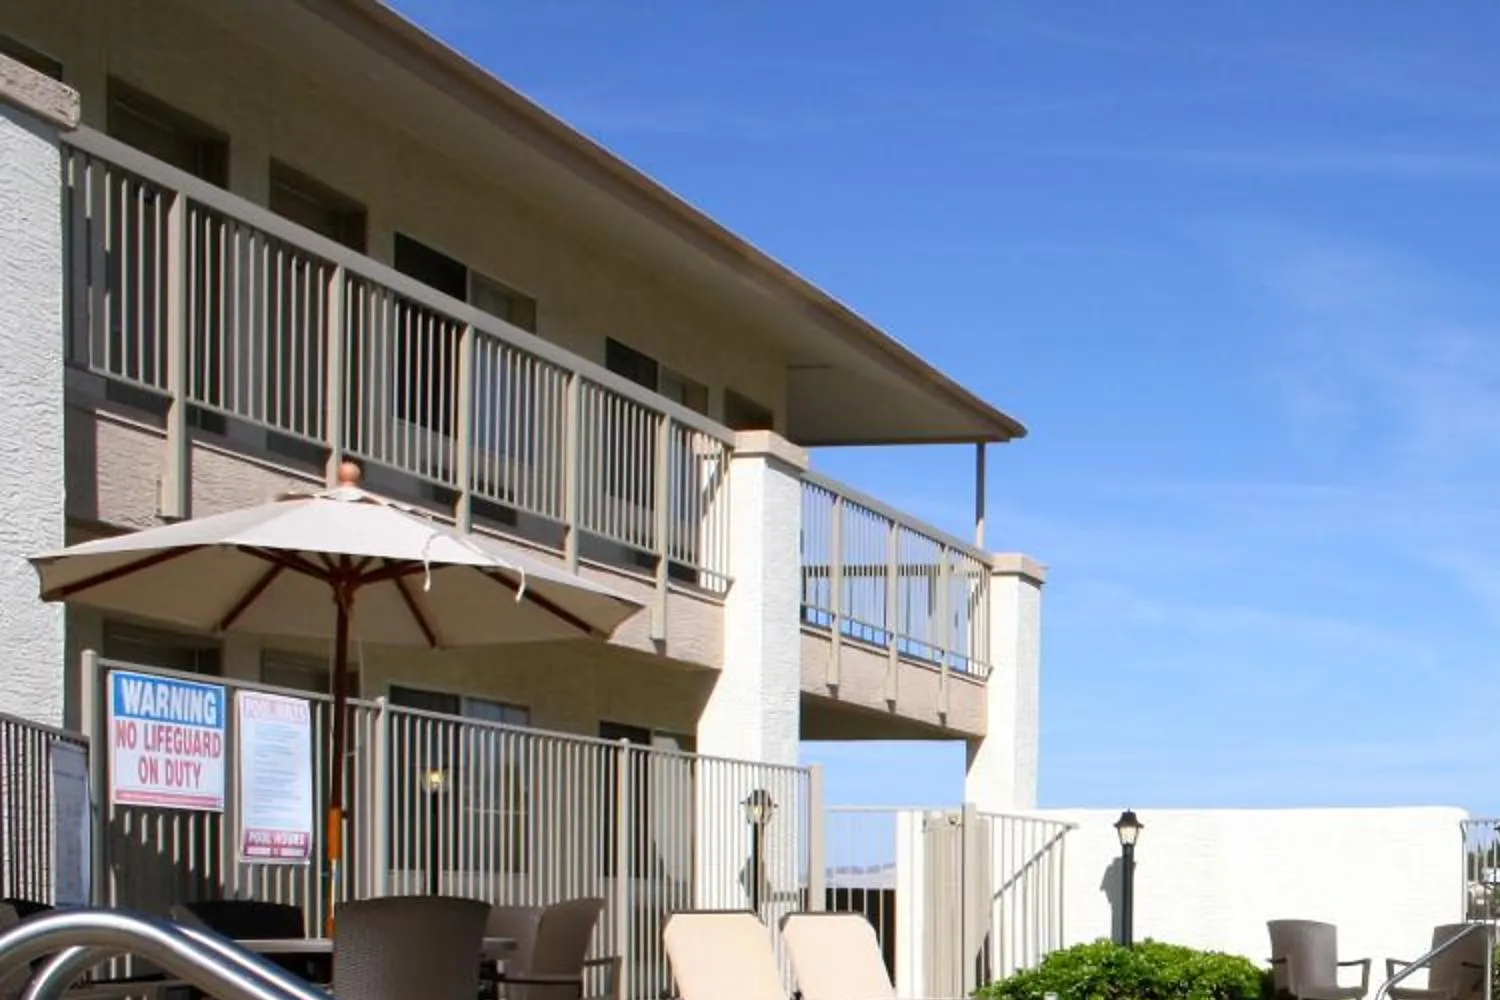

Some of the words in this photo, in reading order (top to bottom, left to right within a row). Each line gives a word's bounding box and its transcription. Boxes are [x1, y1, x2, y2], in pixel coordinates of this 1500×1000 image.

[122, 679, 216, 725] WARNING
[115, 719, 137, 750] NO
[143, 724, 222, 759] LIFEGUARD
[137, 756, 159, 785] ON
[165, 757, 202, 789] DUTY
